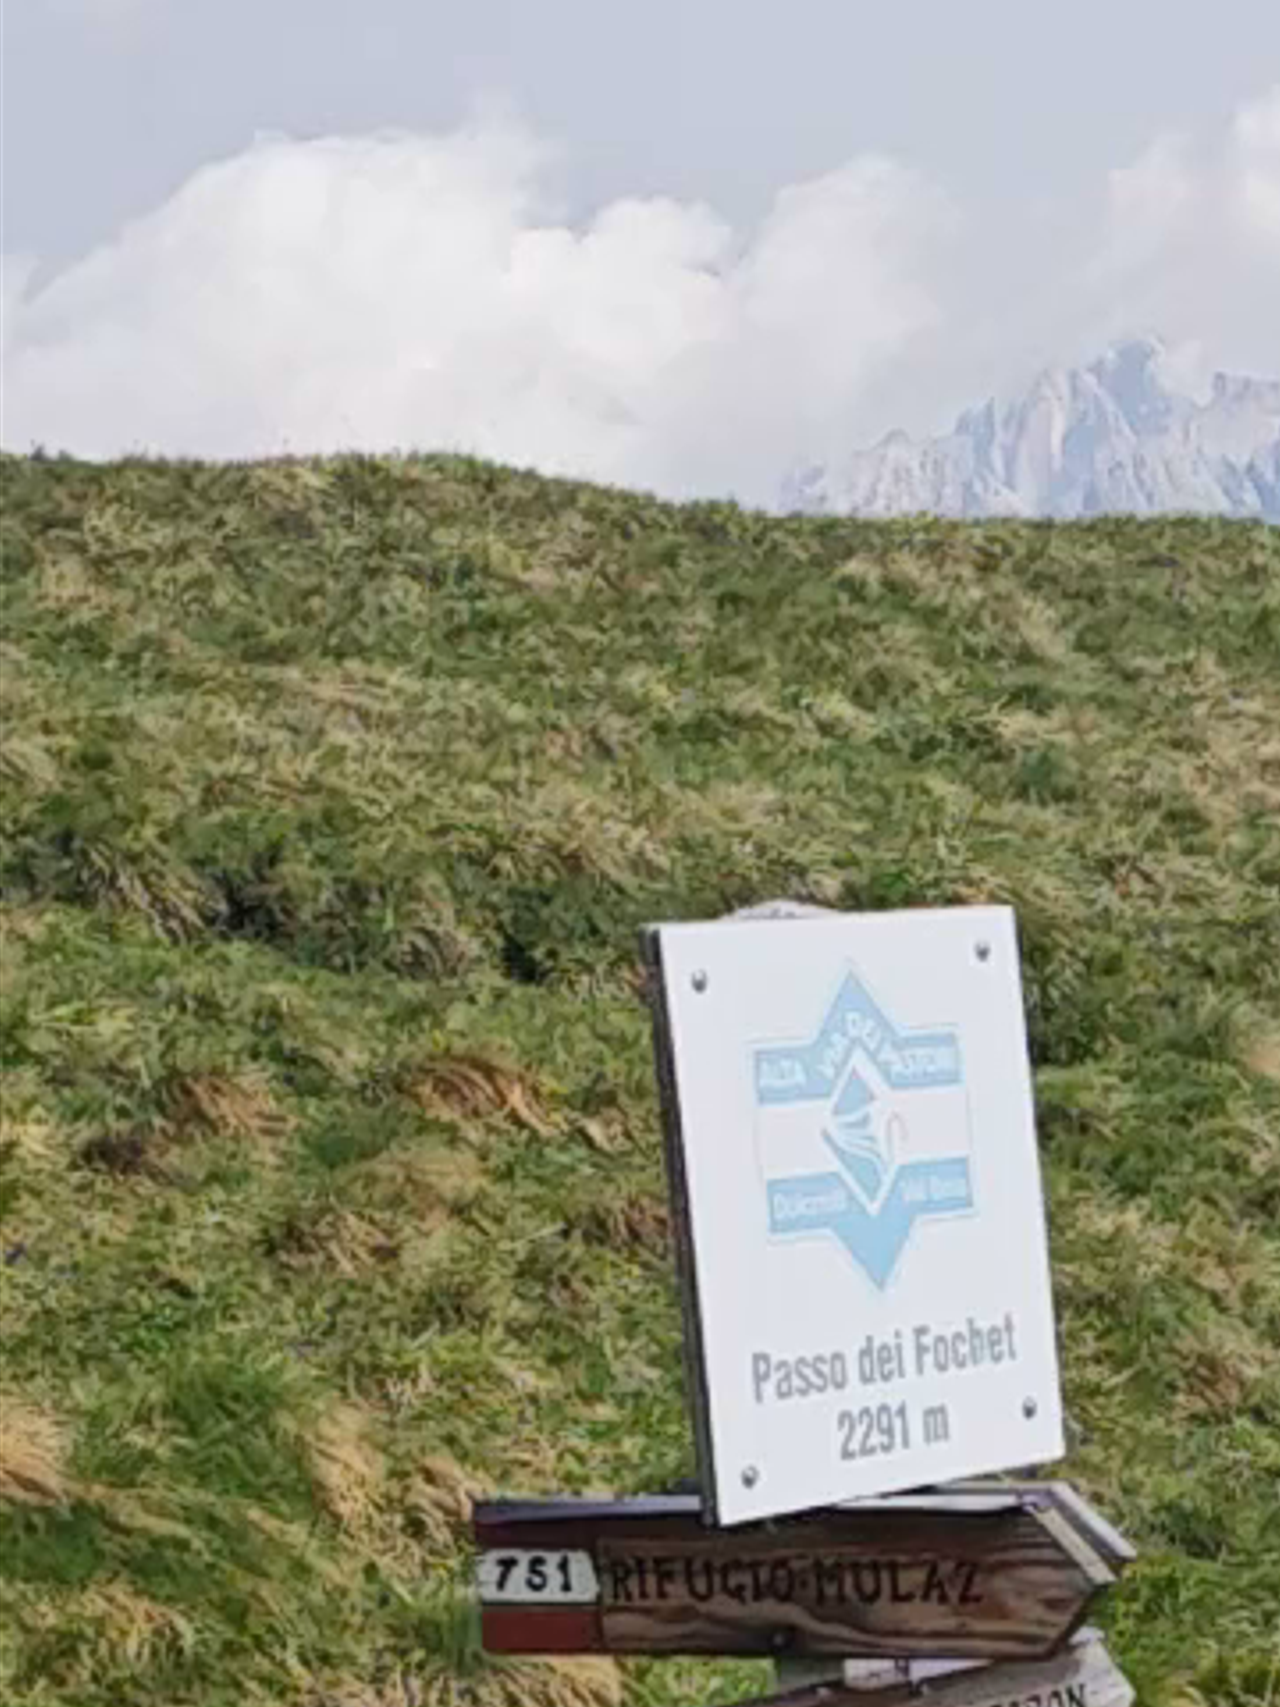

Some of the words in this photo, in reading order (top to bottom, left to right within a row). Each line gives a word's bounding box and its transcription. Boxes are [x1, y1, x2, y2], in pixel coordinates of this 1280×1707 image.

[751, 1350, 849, 1405] Passo
[857, 1328, 906, 1387] dei
[912, 1311, 1017, 1377] Fochet
[836, 1399, 911, 1461] 2291
[921, 1403, 951, 1446] m
[494, 1554, 576, 1595] 751
